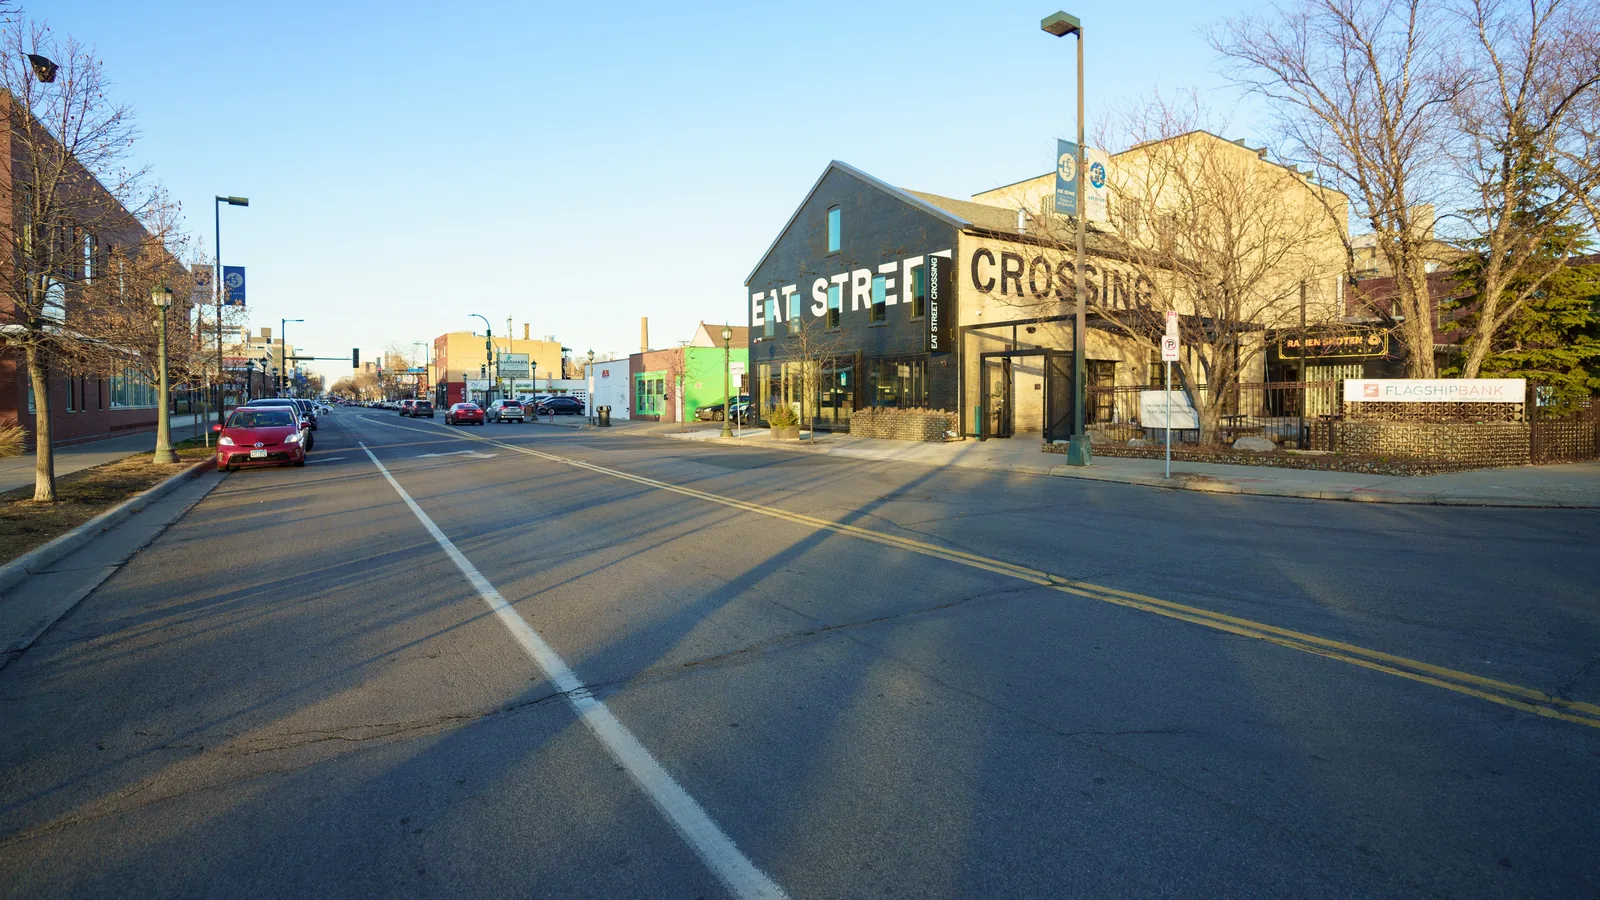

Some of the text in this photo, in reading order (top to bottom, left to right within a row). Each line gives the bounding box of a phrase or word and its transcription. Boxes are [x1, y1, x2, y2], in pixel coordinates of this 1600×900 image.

[752, 284, 797, 327] EAT
[930, 257, 938, 349] EAT STREET CROSSING
[971, 247, 1153, 311] CROSSING
[1385, 385, 1504, 396] FLAGSHIPBANK
